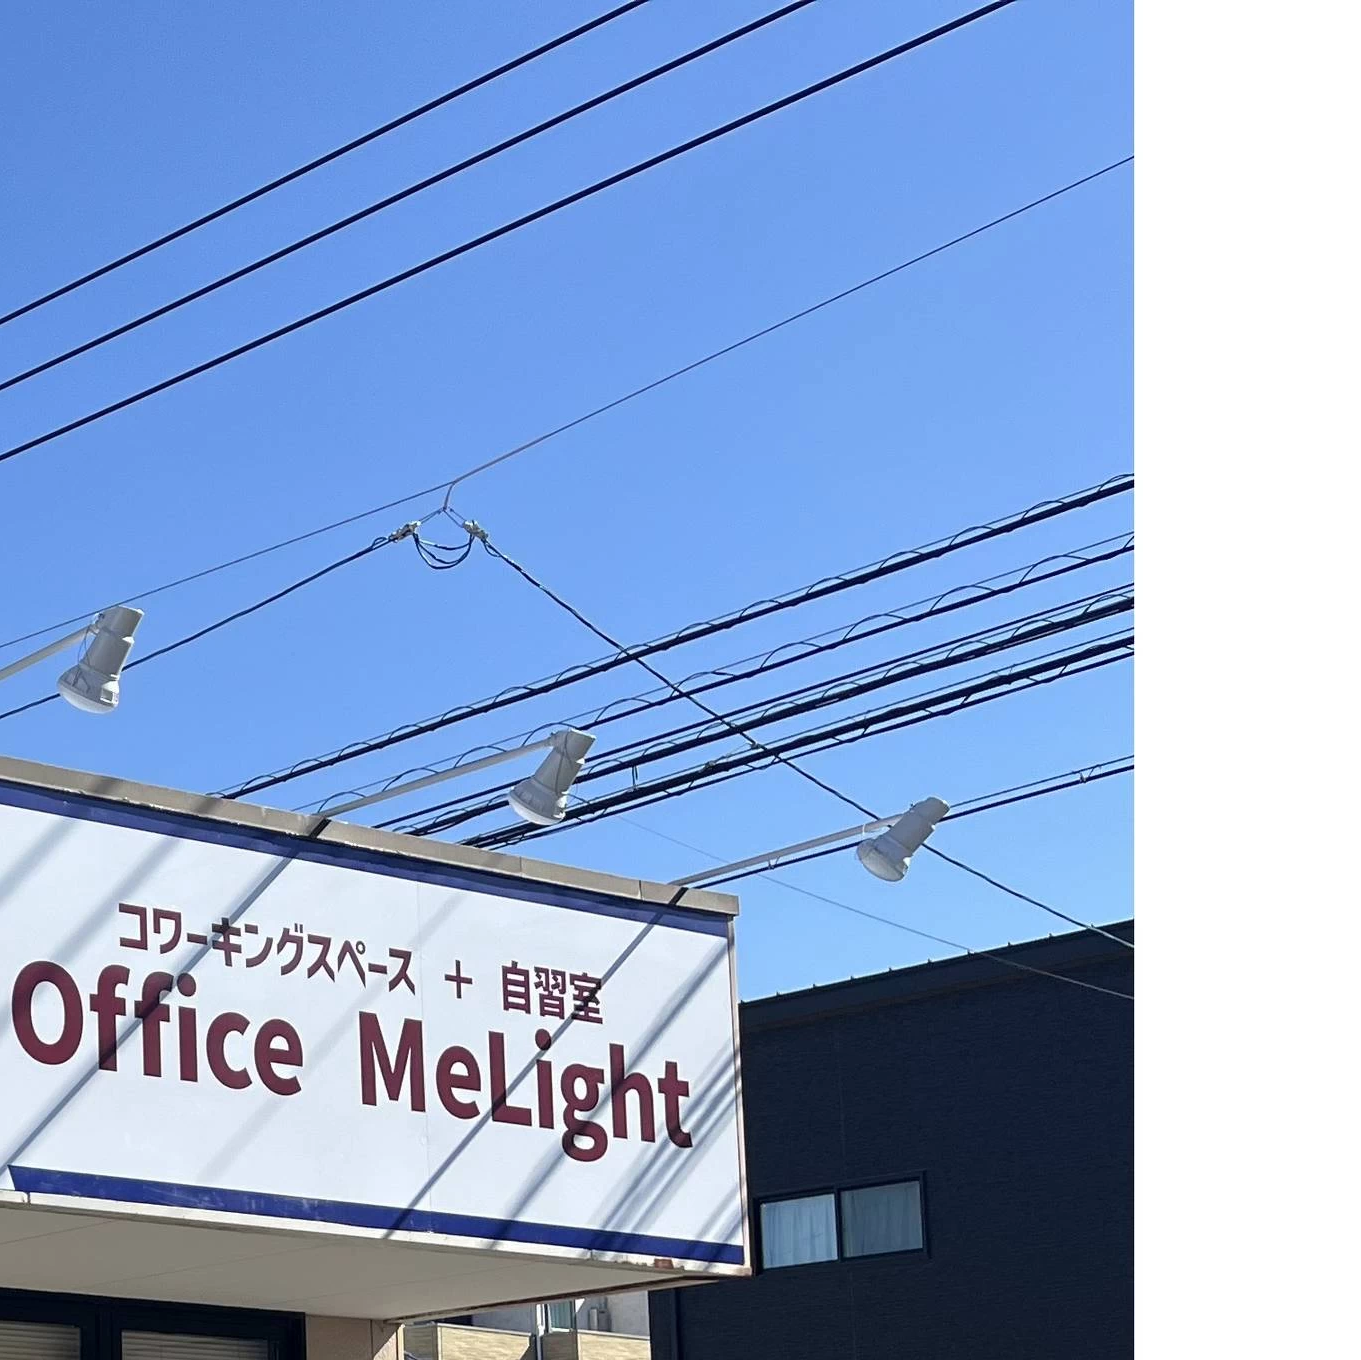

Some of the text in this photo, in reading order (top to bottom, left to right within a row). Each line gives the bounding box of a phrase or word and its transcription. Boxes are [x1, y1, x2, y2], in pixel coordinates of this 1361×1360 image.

[118, 902, 416, 996] コワーキングスペース
[501, 960, 604, 1025] 自習室
[11, 960, 694, 1163] Office MeLight
